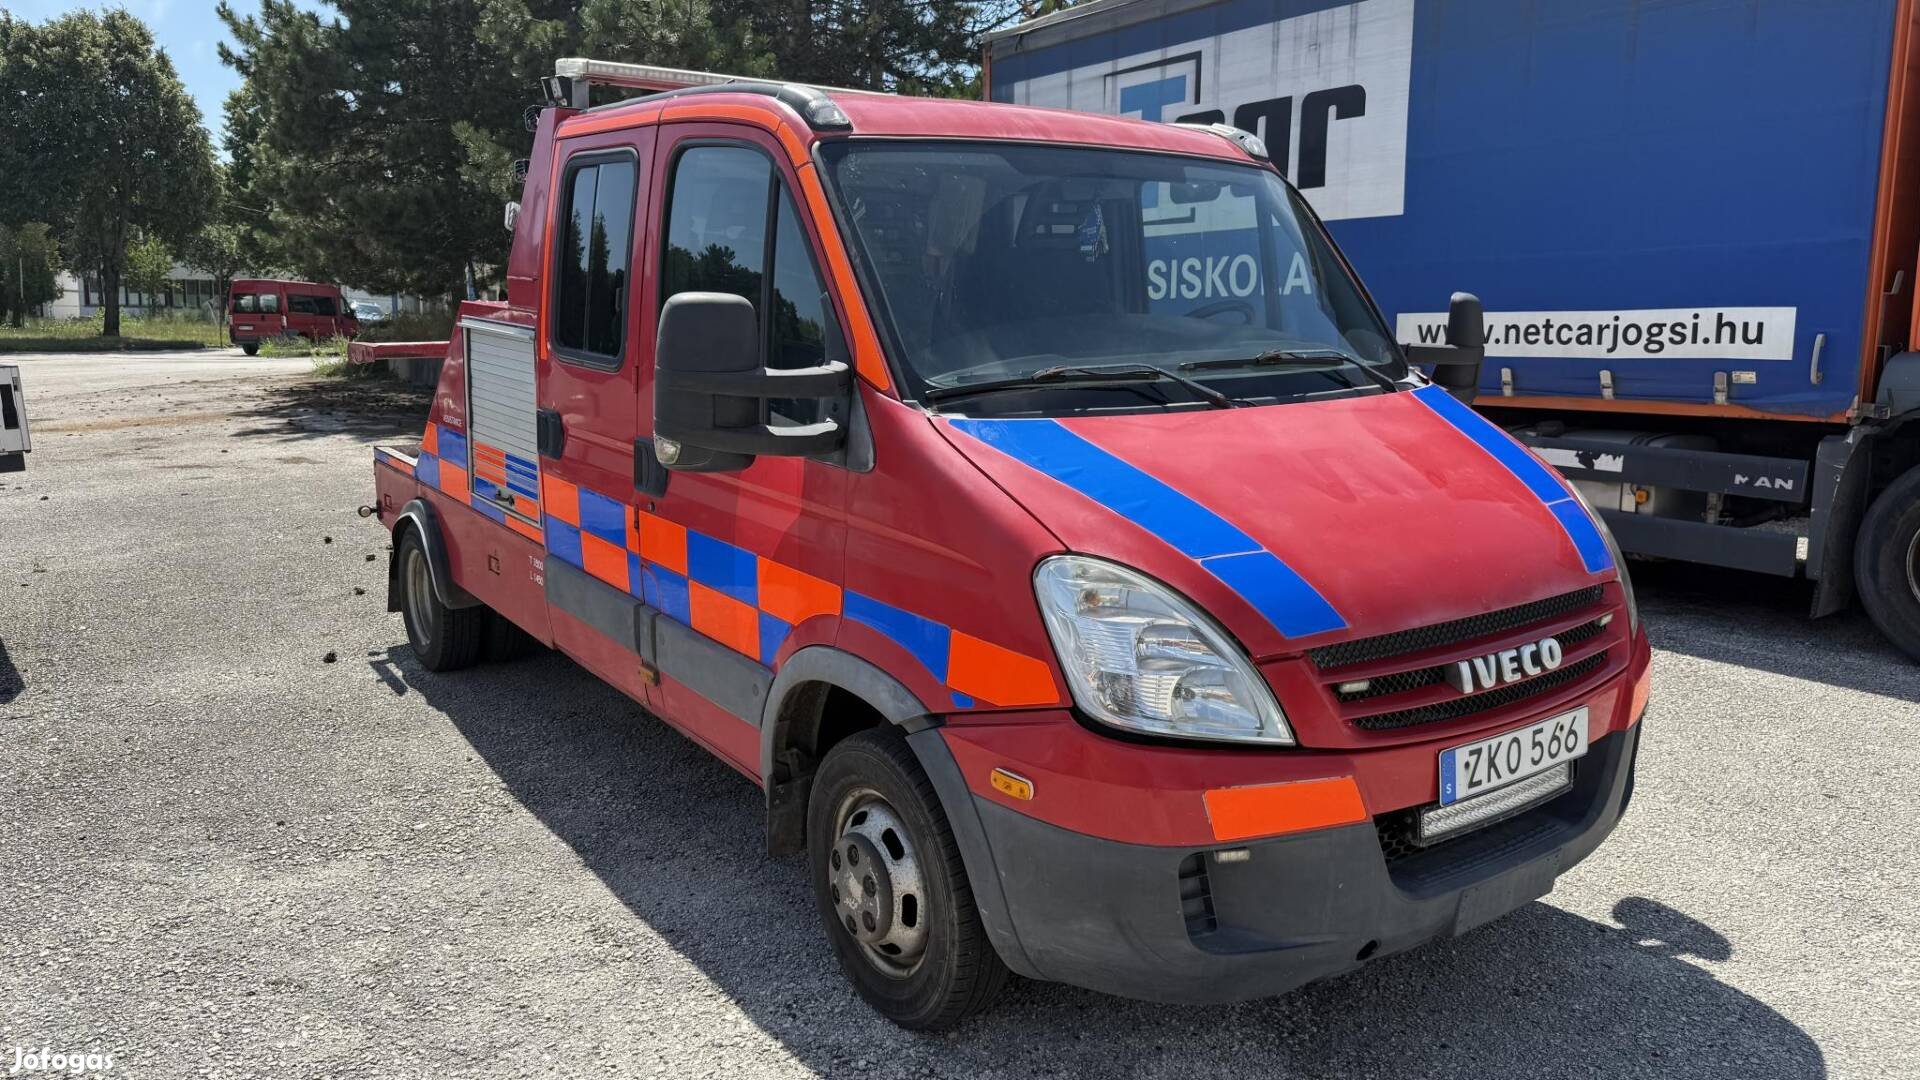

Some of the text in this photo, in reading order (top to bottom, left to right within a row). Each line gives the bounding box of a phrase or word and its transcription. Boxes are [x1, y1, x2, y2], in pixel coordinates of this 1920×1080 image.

[1147, 251, 1312, 300] SISKOA
[1457, 637, 1563, 694] IVECO
[1467, 715, 1579, 790] ZKO 566
[1445, 782, 1452, 795] S
